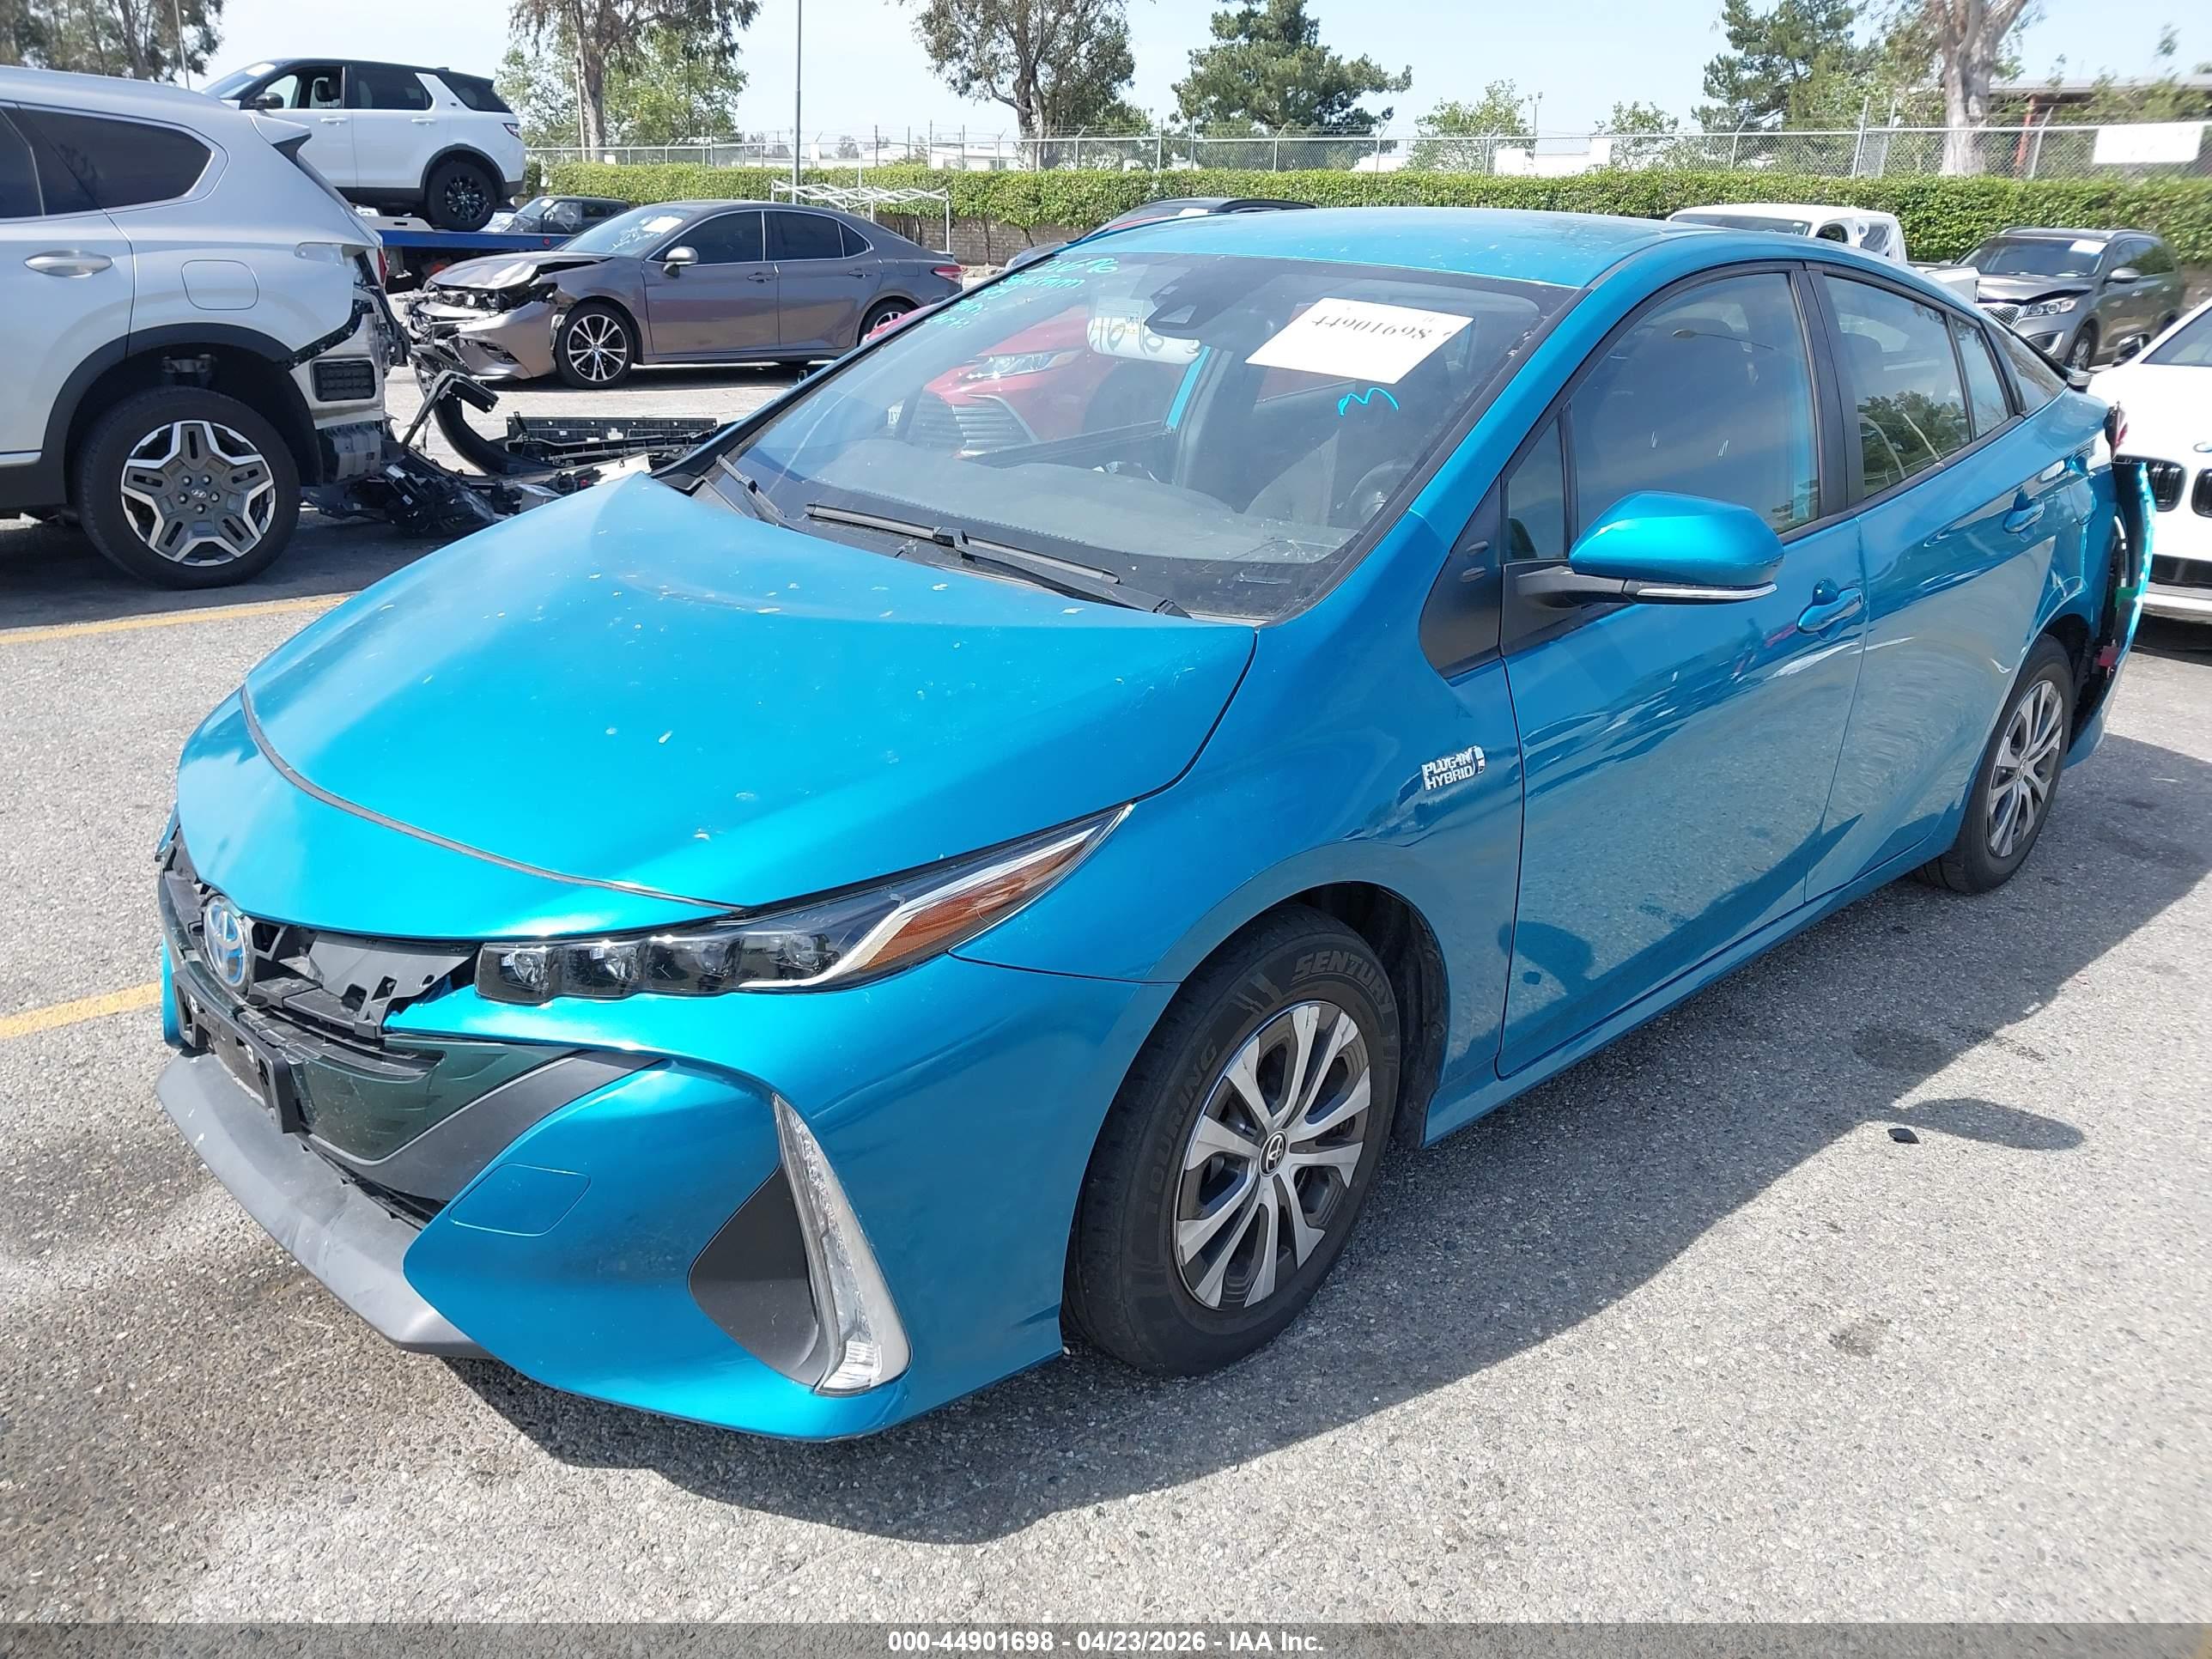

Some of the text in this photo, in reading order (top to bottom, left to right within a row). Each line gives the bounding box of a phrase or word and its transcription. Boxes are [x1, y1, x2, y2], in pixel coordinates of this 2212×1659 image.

[1311, 315, 1433, 340] 44901698
[1425, 765, 1474, 791] HYBRID
[1291, 950, 1395, 1014] SENTURY
